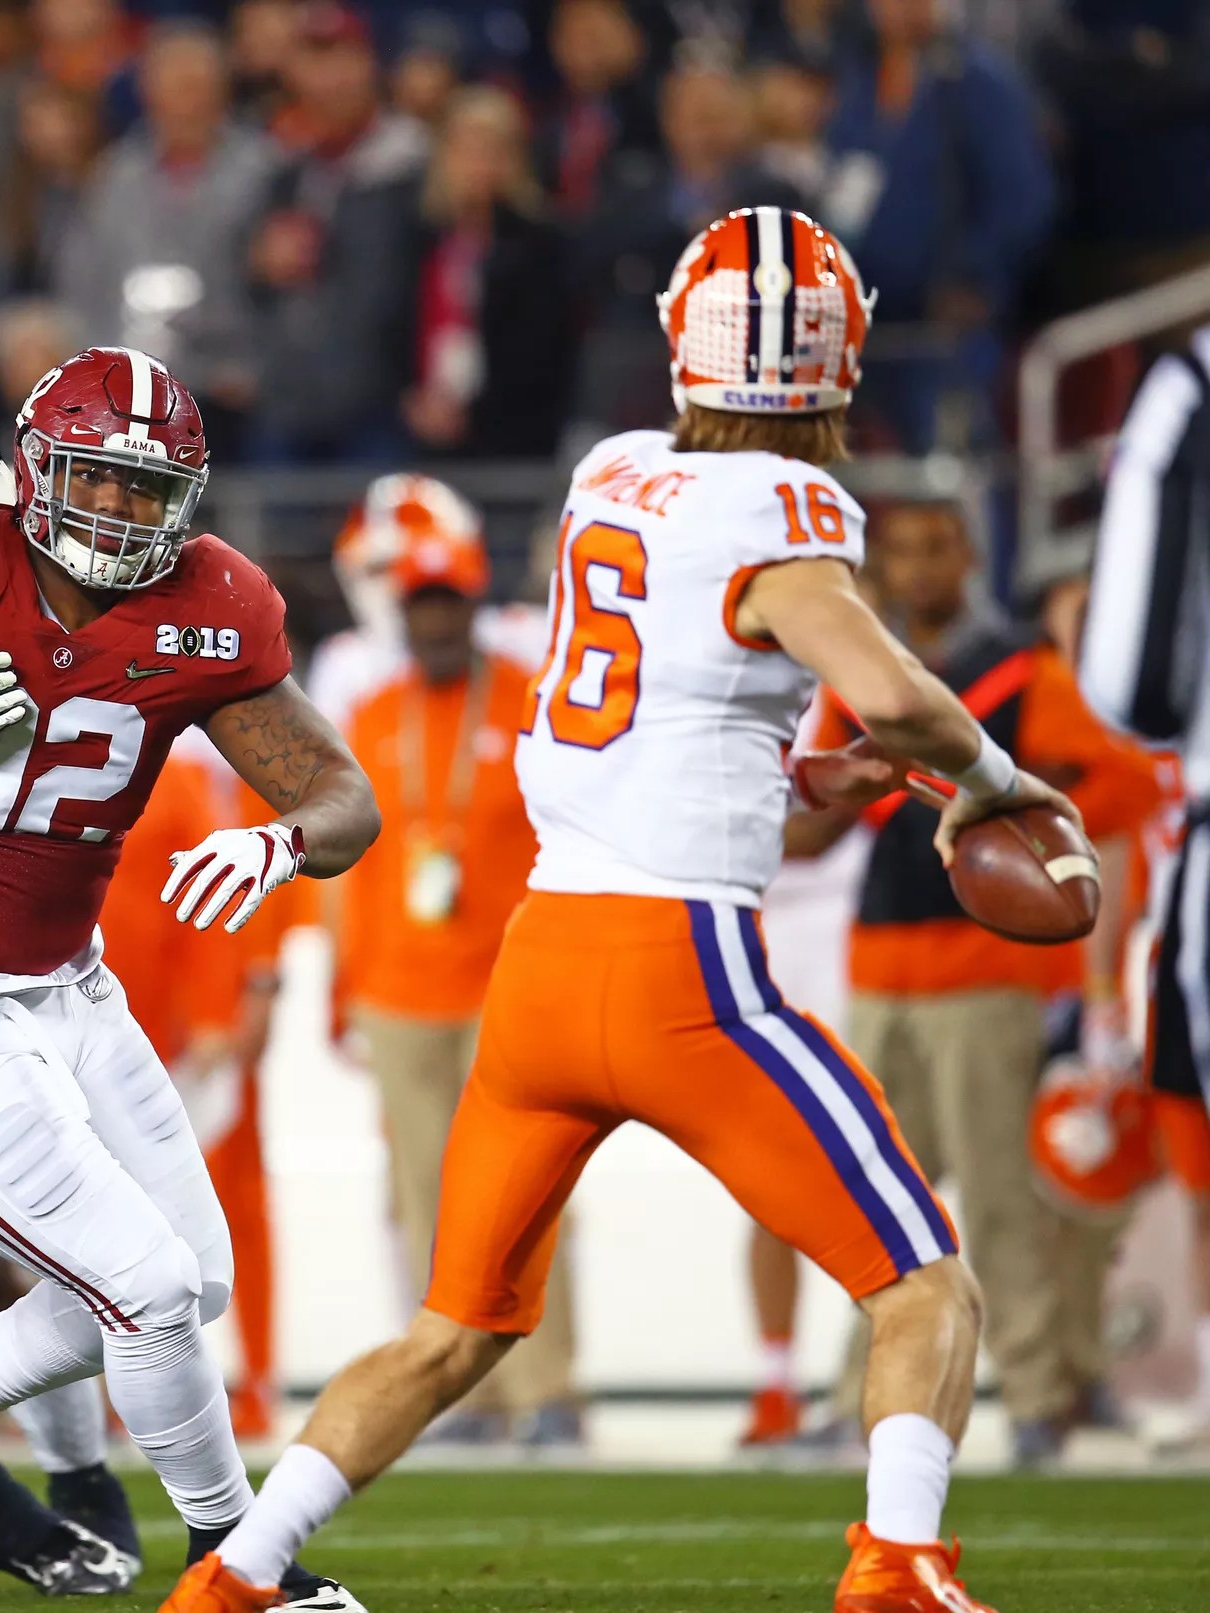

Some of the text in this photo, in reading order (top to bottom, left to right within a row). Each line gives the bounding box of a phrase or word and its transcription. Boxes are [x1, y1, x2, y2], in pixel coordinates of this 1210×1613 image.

[123, 439, 156, 453] BAMA
[775, 482, 846, 545] 16
[155, 623, 241, 661] 2019
